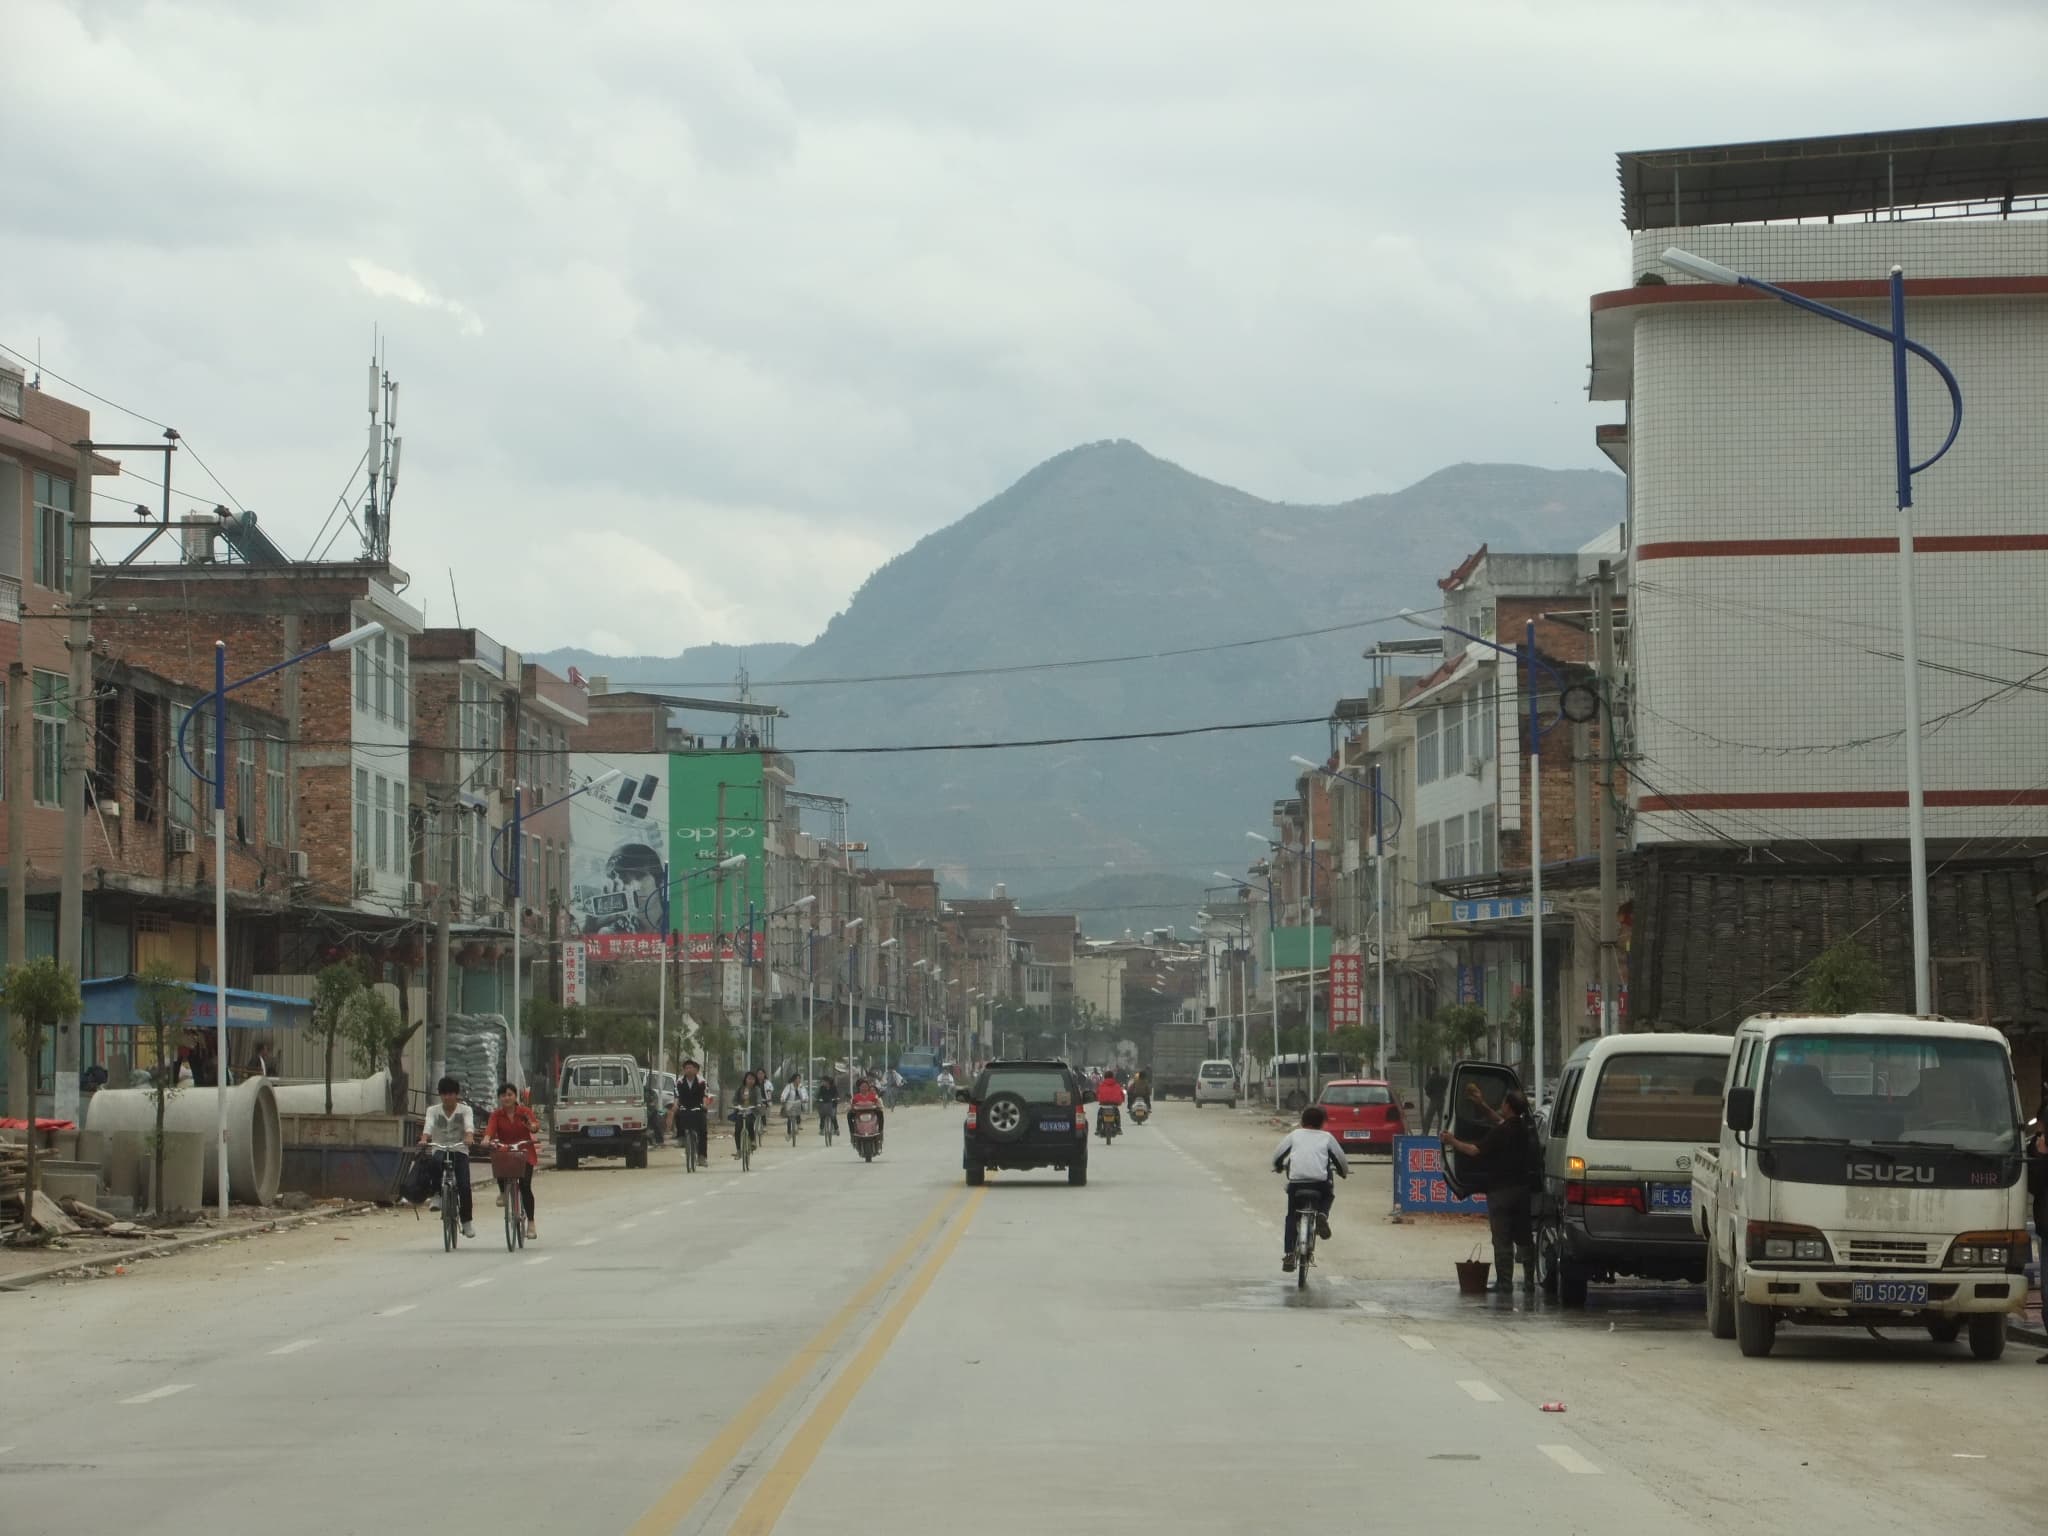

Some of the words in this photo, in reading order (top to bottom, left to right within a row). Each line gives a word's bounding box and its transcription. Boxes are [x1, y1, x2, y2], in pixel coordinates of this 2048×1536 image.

[1846, 1163, 1935, 1183] ISUZU
[1970, 1172, 1999, 1185] NHR
[1672, 1189, 1692, 1205] 56
[1878, 1284, 1926, 1302] 50279
